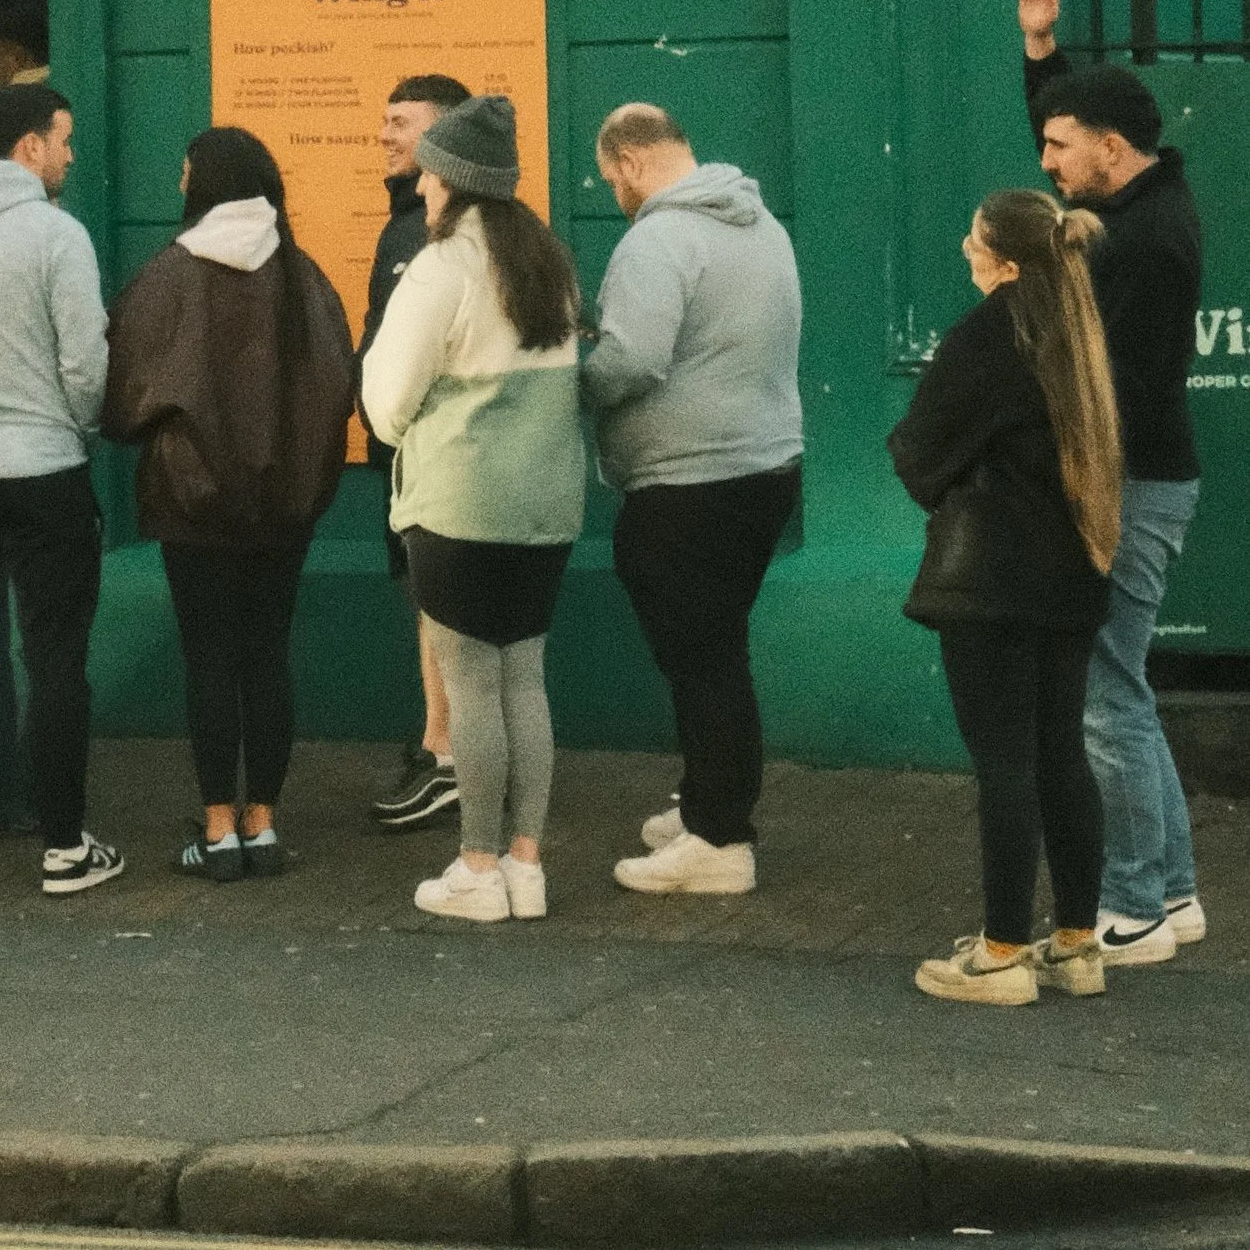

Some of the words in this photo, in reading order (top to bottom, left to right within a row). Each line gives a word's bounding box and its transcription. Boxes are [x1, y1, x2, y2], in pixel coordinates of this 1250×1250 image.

[233, 43, 265, 55] How
[271, 41, 335, 56] peckish?
[290, 132, 323, 145] How
[327, 134, 370, 147] saucy
